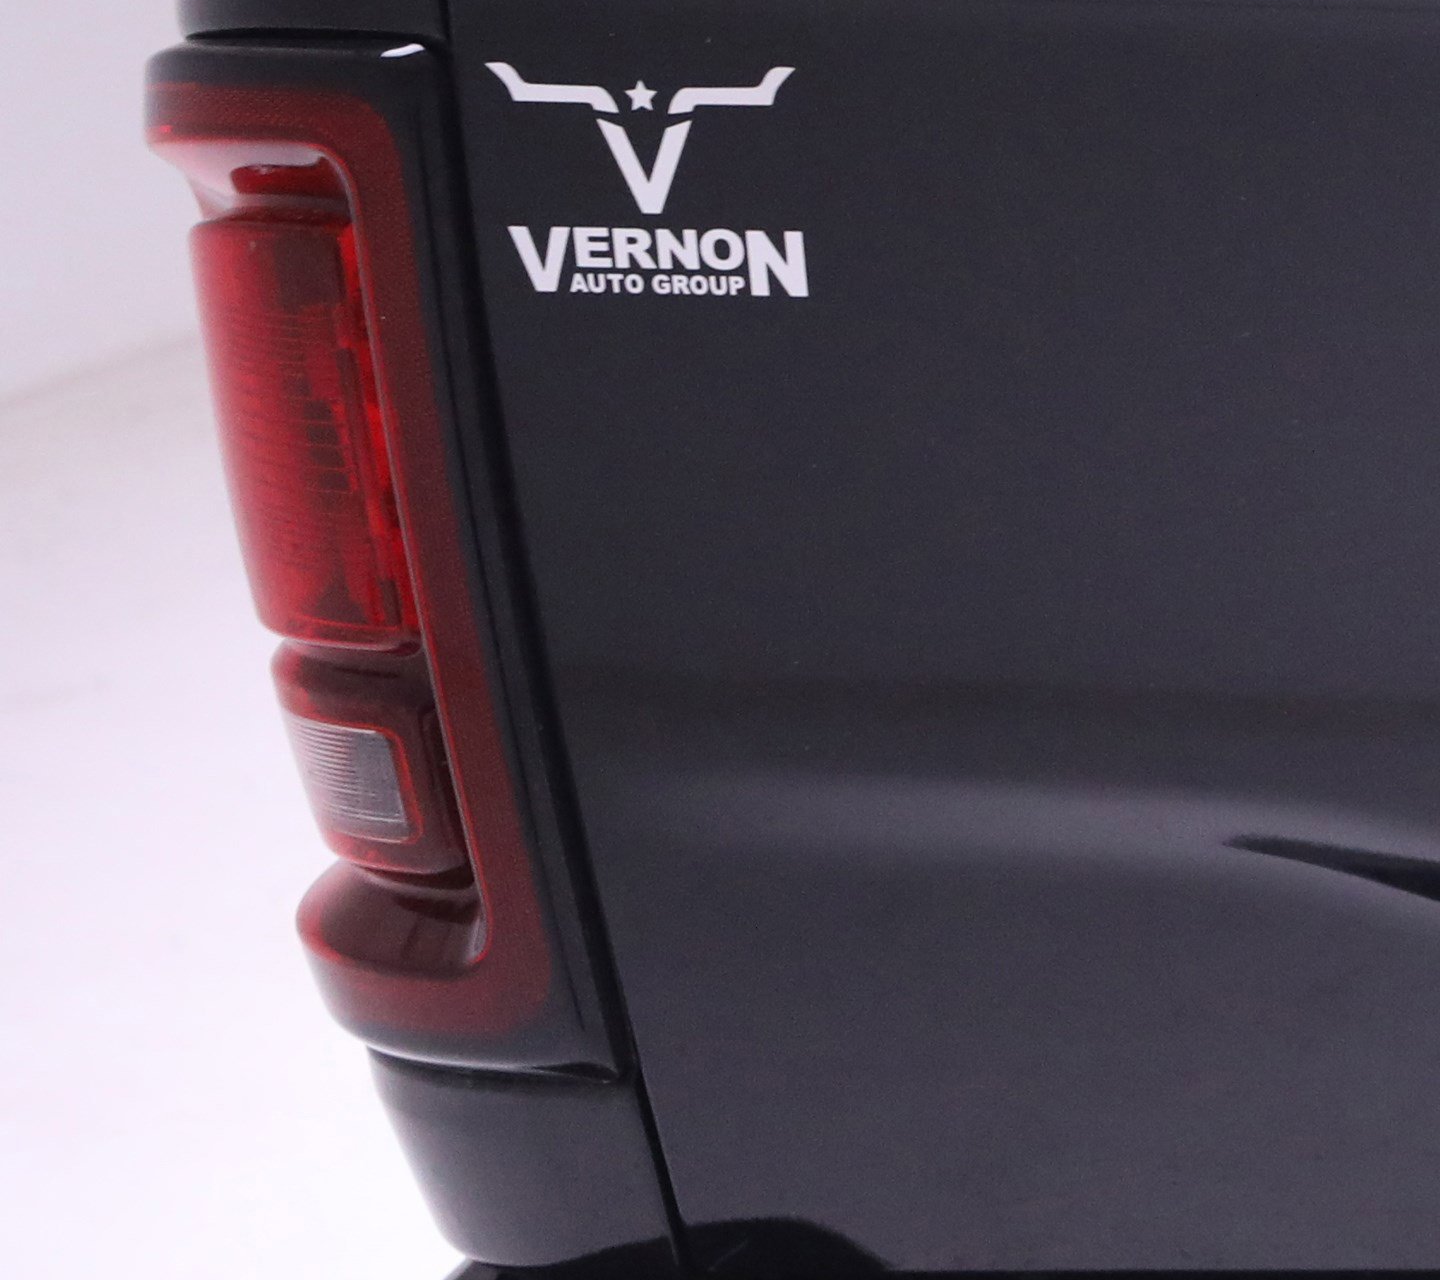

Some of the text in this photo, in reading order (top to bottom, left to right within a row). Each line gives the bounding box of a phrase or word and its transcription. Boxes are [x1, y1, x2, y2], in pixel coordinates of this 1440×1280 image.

[507, 225, 809, 298] VERNON
[569, 273, 746, 296] AUTO GROUP
